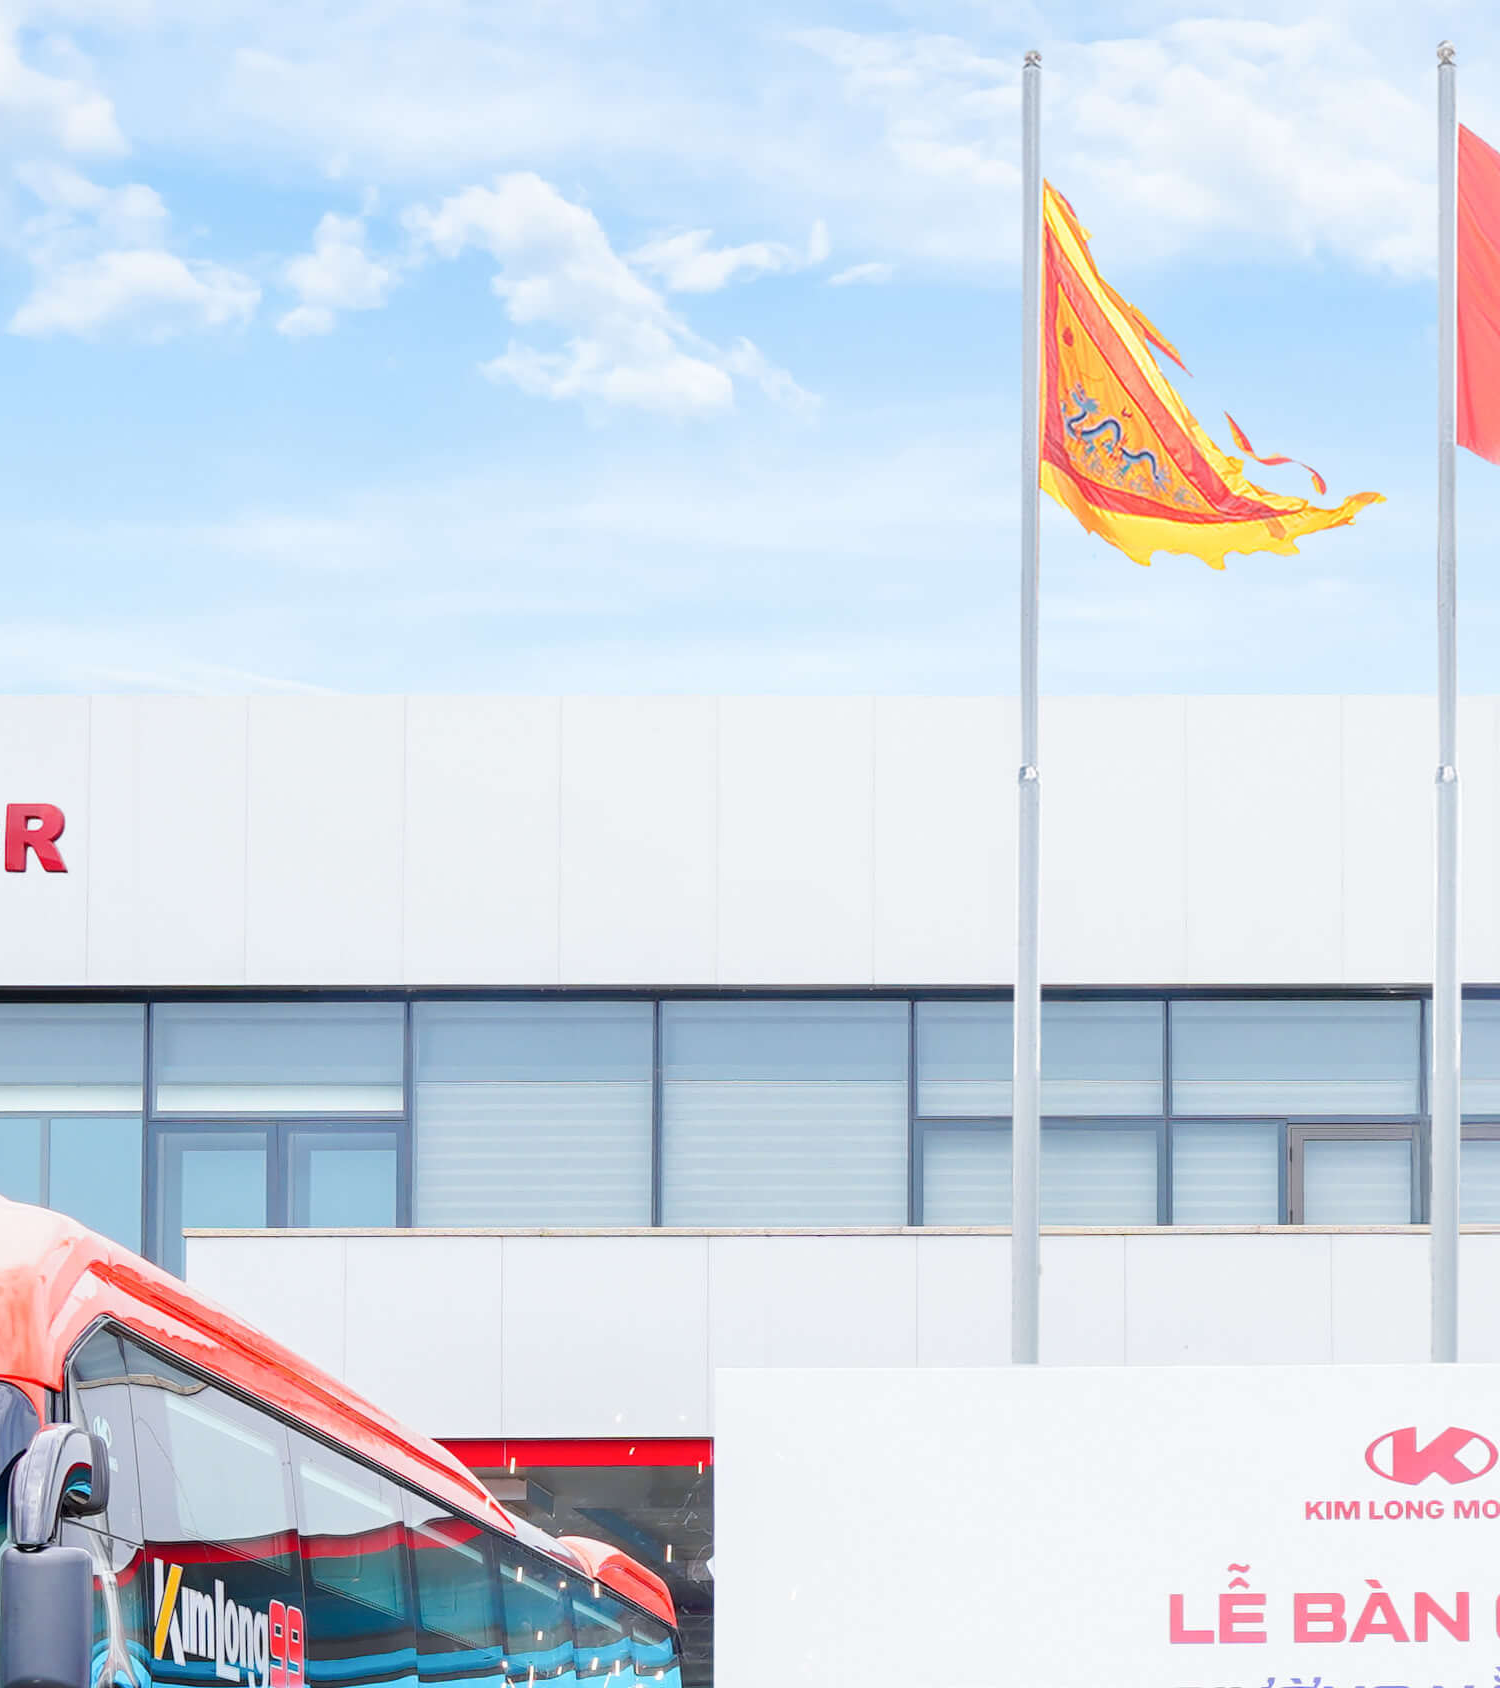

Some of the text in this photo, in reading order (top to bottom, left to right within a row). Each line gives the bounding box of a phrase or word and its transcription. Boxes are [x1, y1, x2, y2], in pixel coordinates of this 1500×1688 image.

[1305, 1500, 1361, 1521] KIM
[1368, 1499, 1445, 1521] LONG
[1169, 1563, 1267, 1644] LỄ
[1293, 1578, 1470, 1644] BÀN
